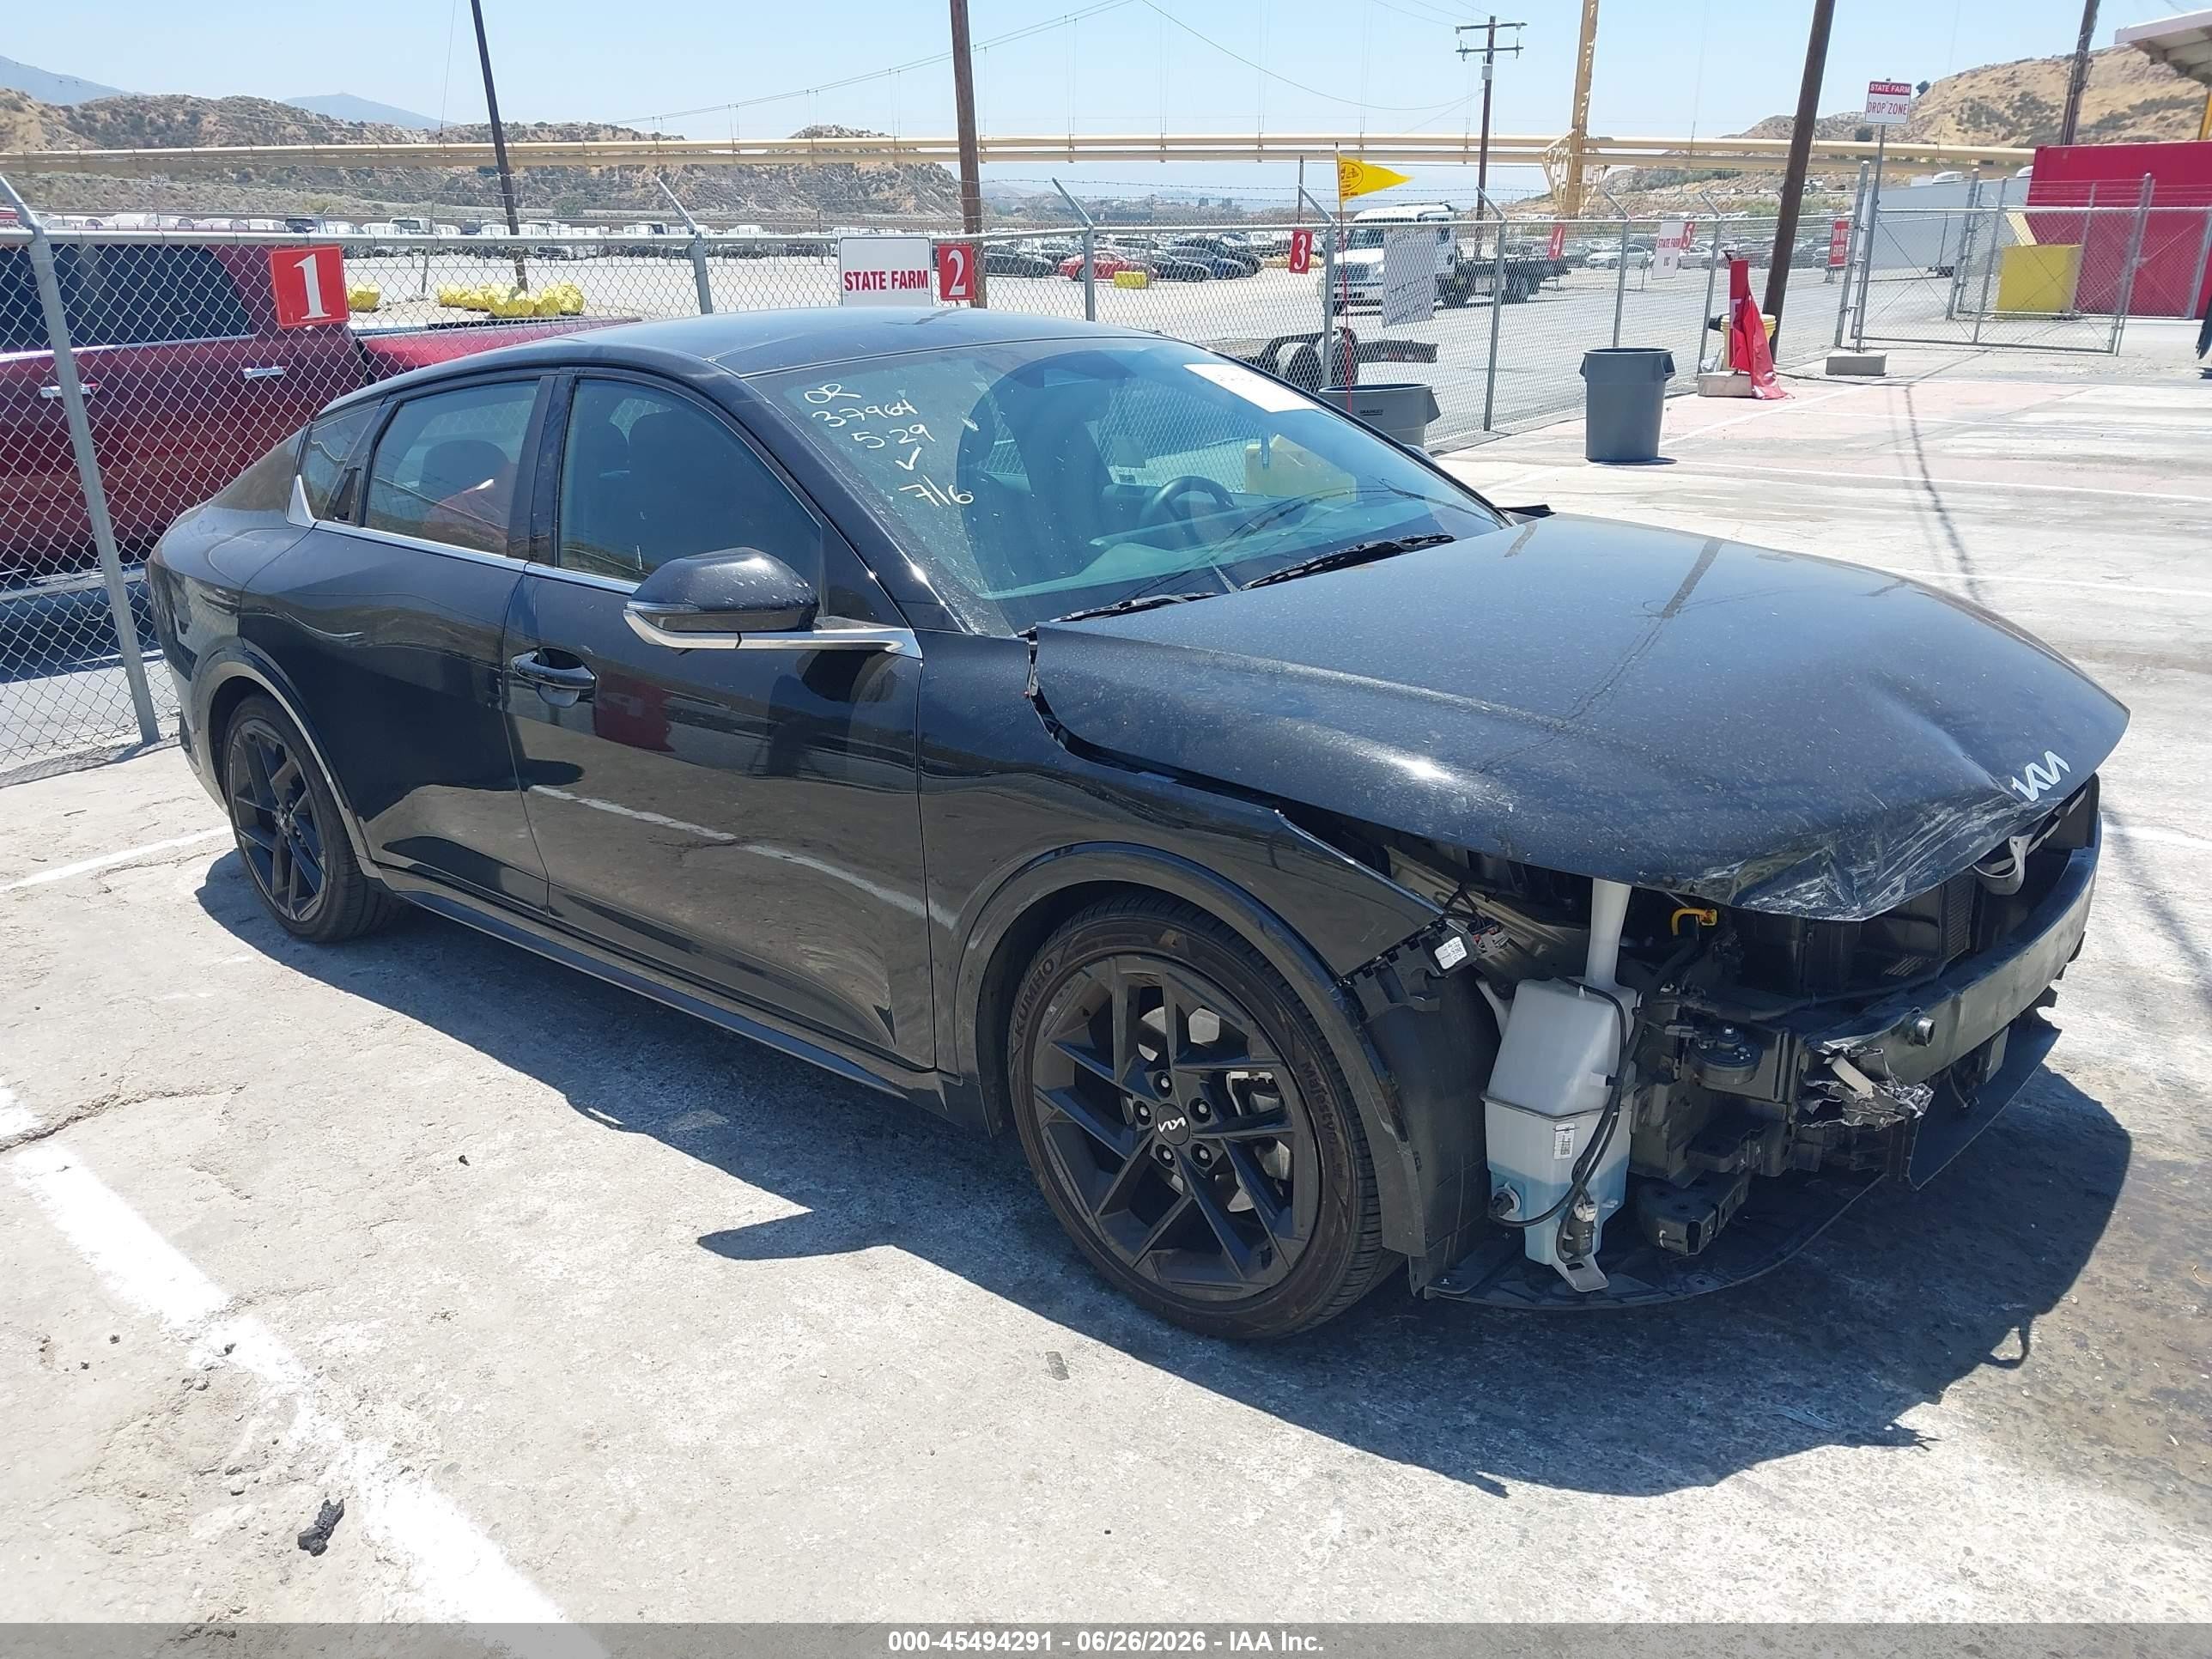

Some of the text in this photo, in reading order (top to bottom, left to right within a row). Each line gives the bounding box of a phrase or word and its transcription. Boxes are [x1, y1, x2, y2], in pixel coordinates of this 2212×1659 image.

[1870, 83, 1911, 94] STATE FARM
[1868, 101, 1907, 115] DROP ZONE
[1553, 228, 1563, 256] 4
[1681, 222, 1694, 247] 5
[1293, 234, 1307, 270] 3
[293, 253, 331, 319] 1
[844, 270, 928, 291] STATE FARM
[947, 249, 967, 296] 2
[804, 383, 862, 404] OR
[812, 398, 919, 428] 37964
[1014, 957, 1054, 1039] KUMHO
